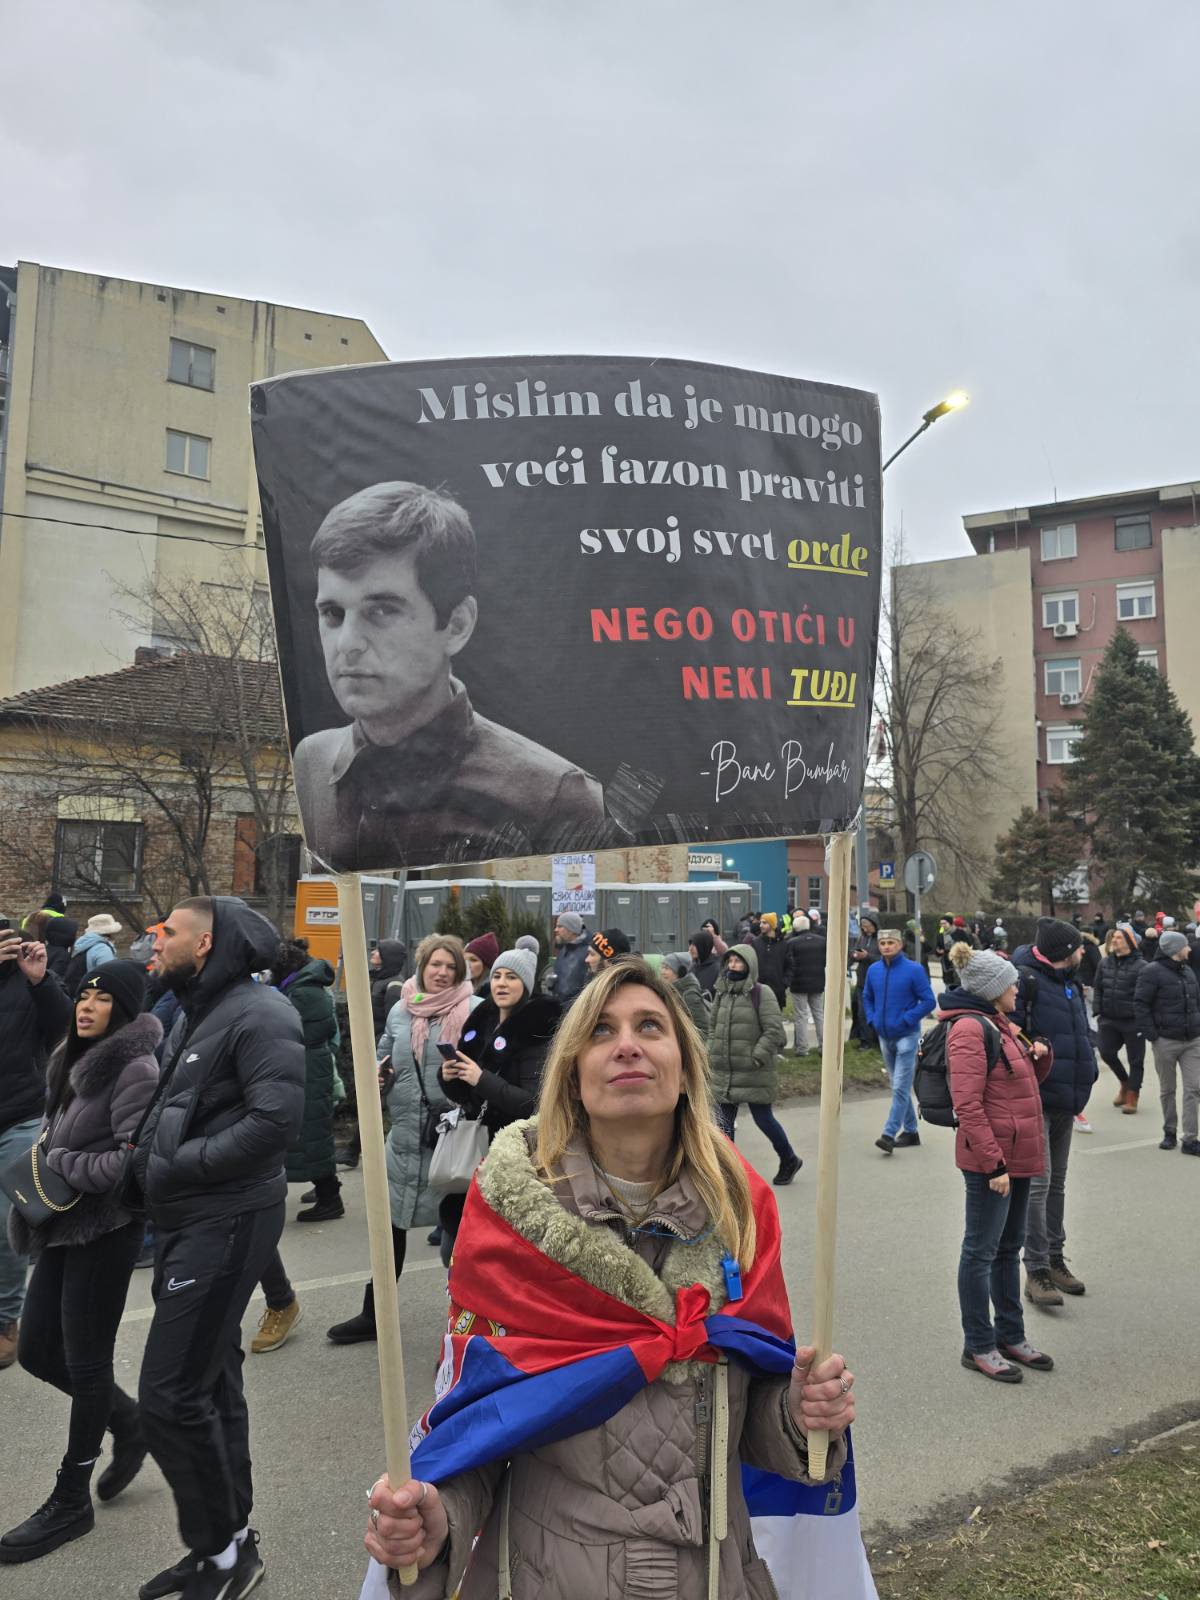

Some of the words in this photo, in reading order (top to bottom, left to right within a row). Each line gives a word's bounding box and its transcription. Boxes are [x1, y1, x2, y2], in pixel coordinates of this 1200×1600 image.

[416, 377, 603, 424] Mislim
[614, 378, 675, 420] da
[684, 384, 724, 430] je
[733, 403, 863, 452] mnogo
[479, 445, 589, 489] veći
[601, 445, 730, 490] fazon
[738, 468, 867, 509] praviti
[579, 515, 682, 564] svoj
[692, 528, 779, 561] svet
[787, 532, 868, 571] ovde
[590, 606, 714, 643] NEGO
[731, 604, 826, 645] OTIĆI
[838, 617, 855, 648] U
[681, 666, 773, 700] NEKI
[790, 668, 857, 703] TUĐI
[781, 739, 850, 800] Bumbar
[882, 864, 892, 878] P
[308, 910, 321, 919] TIP
[322, 910, 339, 919] TOP
